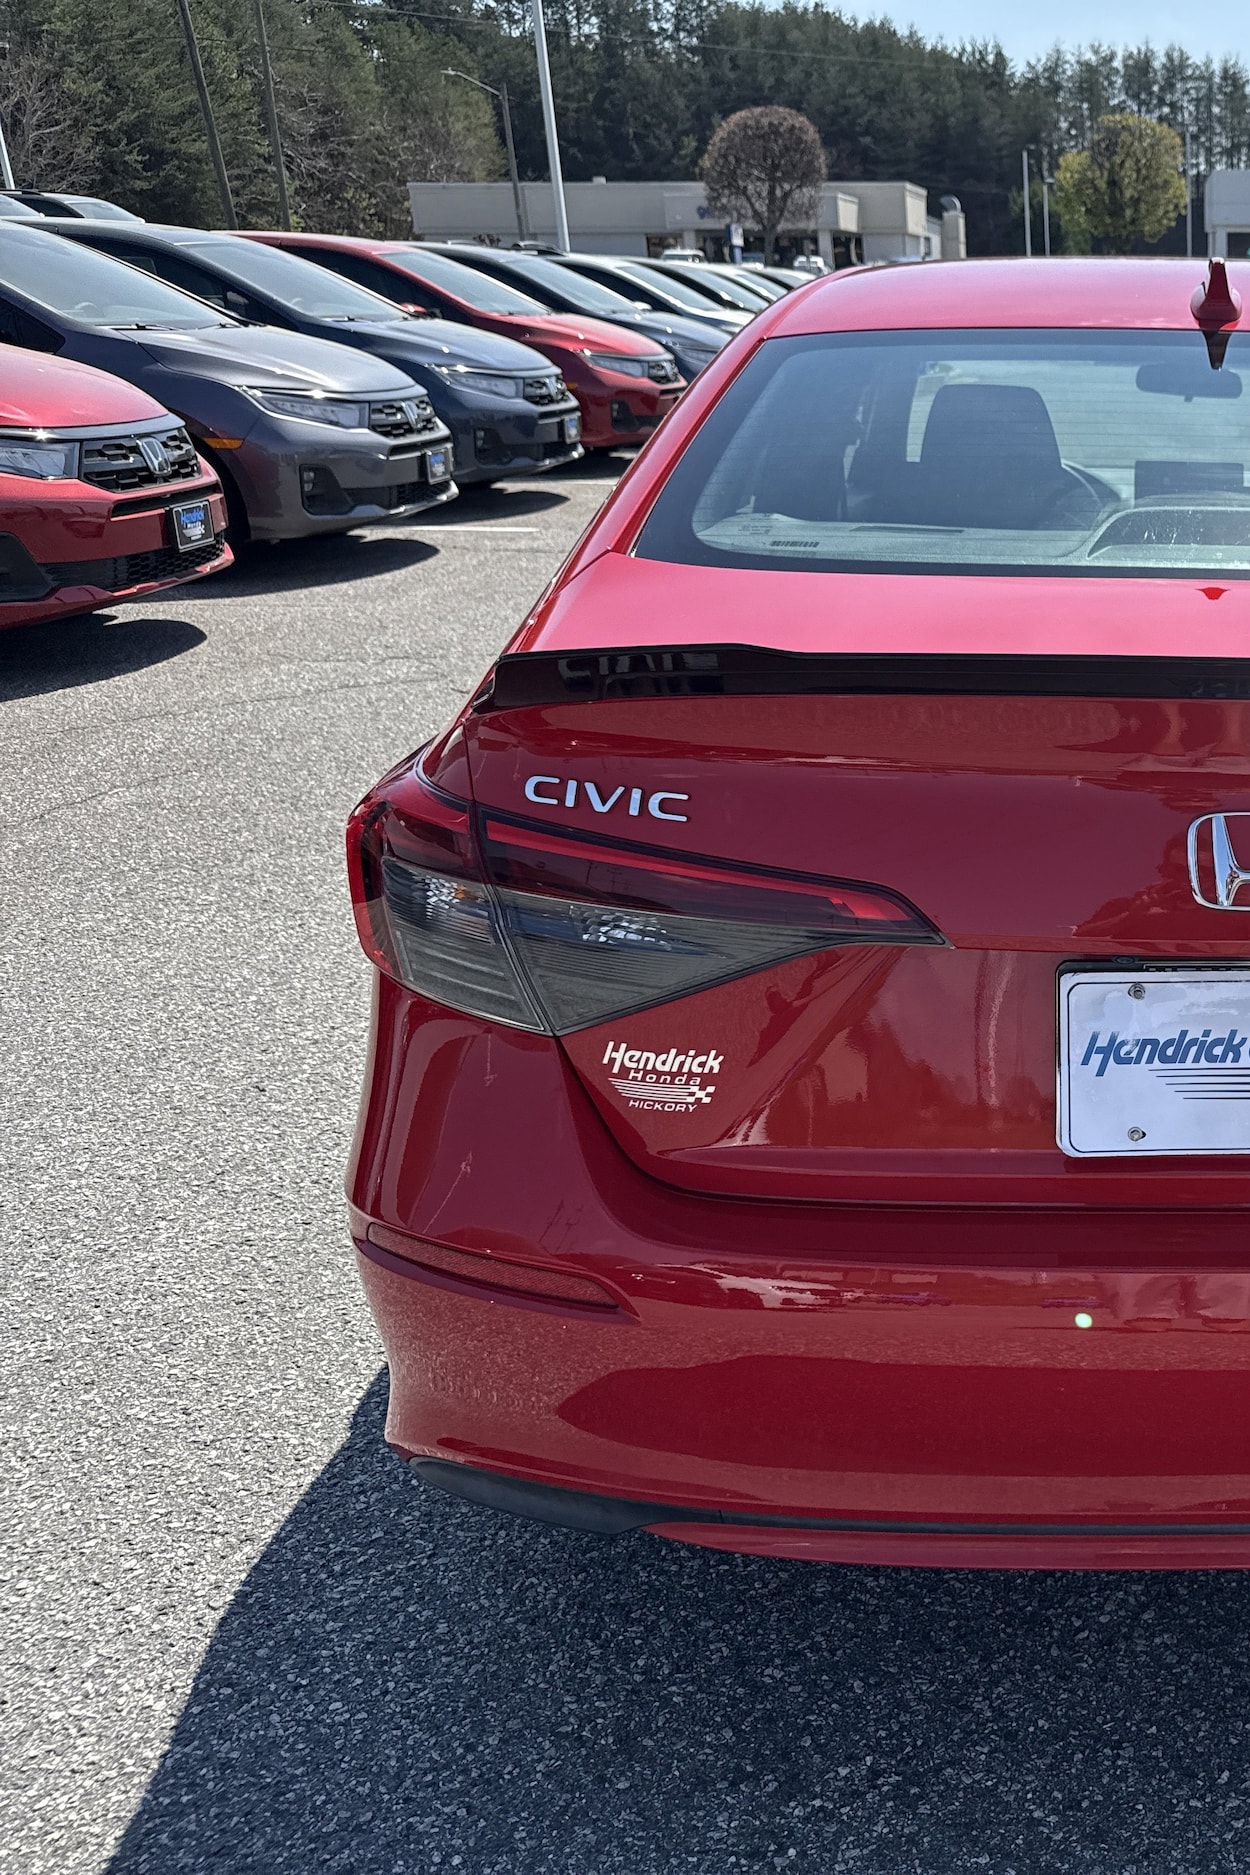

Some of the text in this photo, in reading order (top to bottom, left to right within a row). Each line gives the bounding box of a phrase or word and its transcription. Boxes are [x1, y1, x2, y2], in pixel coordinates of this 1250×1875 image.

[525, 775, 689, 822] CIVIC
[602, 1041, 725, 1074] Hendrick
[628, 1069, 702, 1086] Honda
[628, 1099, 698, 1113] HICKORY
